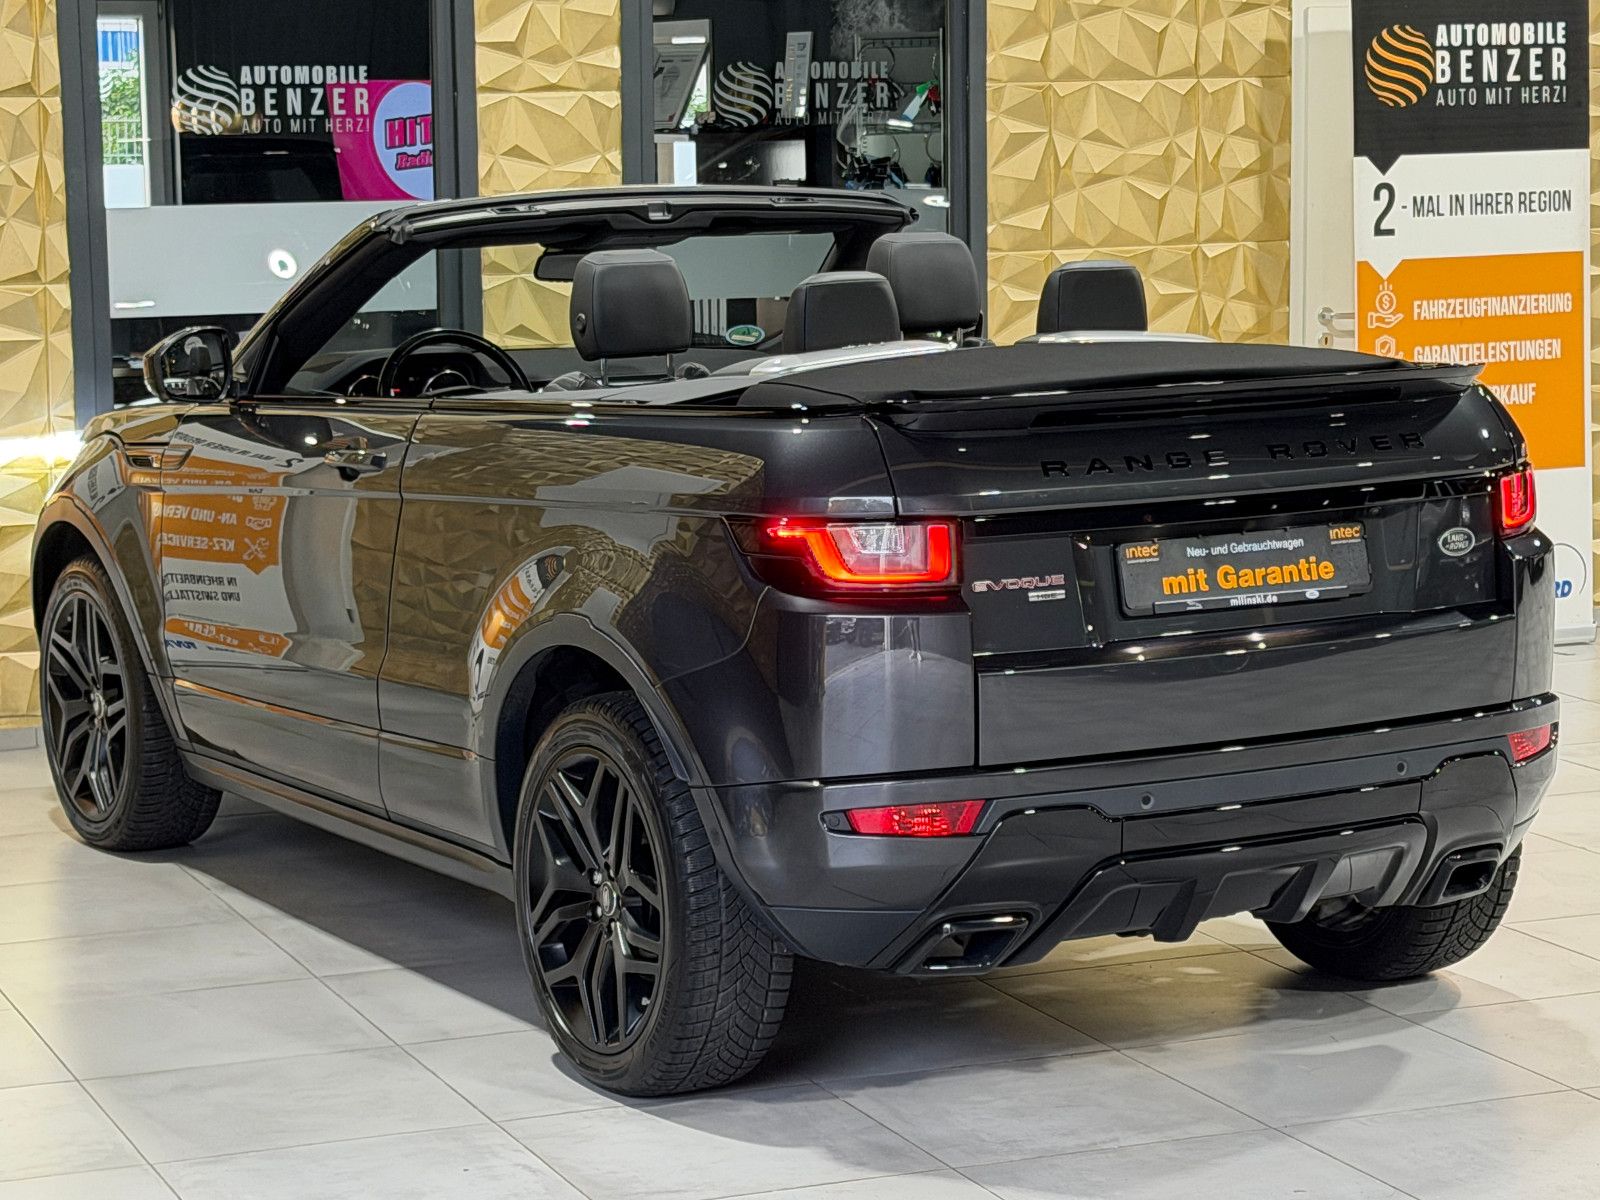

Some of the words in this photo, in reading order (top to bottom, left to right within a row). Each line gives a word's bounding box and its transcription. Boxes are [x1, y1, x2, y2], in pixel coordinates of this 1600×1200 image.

[1435, 21, 1567, 47] AUTOMOBILE
[240, 66, 368, 85] AUTOMOBILE
[774, 61, 889, 79] AOMOBILE
[1435, 47, 1567, 84] BENZER
[240, 88, 369, 116] BENZER
[774, 82, 890, 109] BNZER
[1436, 87, 1477, 107] AUTO
[1485, 86, 1513, 105] MIT
[1521, 85, 1567, 104] HERZ!
[242, 118, 282, 134] AUTO
[291, 118, 316, 133] MIT
[325, 118, 370, 133] HERZ!
[385, 115, 432, 149] HIT
[394, 151, 432, 171] Radi
[1373, 182, 1396, 237] 2
[1412, 195, 1445, 218] MAL
[1449, 193, 1465, 217] IN
[1469, 191, 1514, 216] IHRER
[1518, 189, 1572, 214] REGION
[1413, 292, 1573, 321] FAHRZEUGFINANZIERUNG
[1413, 338, 1562, 364] GARANTIELEISTUNGEN
[1488, 383, 1537, 405] RKAUF
[1041, 449, 1229, 479] RANGE
[1265, 432, 1425, 461] ROVER
[1329, 525, 1362, 540] intec
[1126, 543, 1160, 559] intec
[1186, 546, 1210, 558] Neu-
[1211, 544, 1229, 556] und
[1230, 538, 1305, 554] Gebrauchtwagen
[972, 574, 1065, 593] EVOQUE
[1162, 568, 1210, 596] mit
[1216, 556, 1336, 590] Garantie
